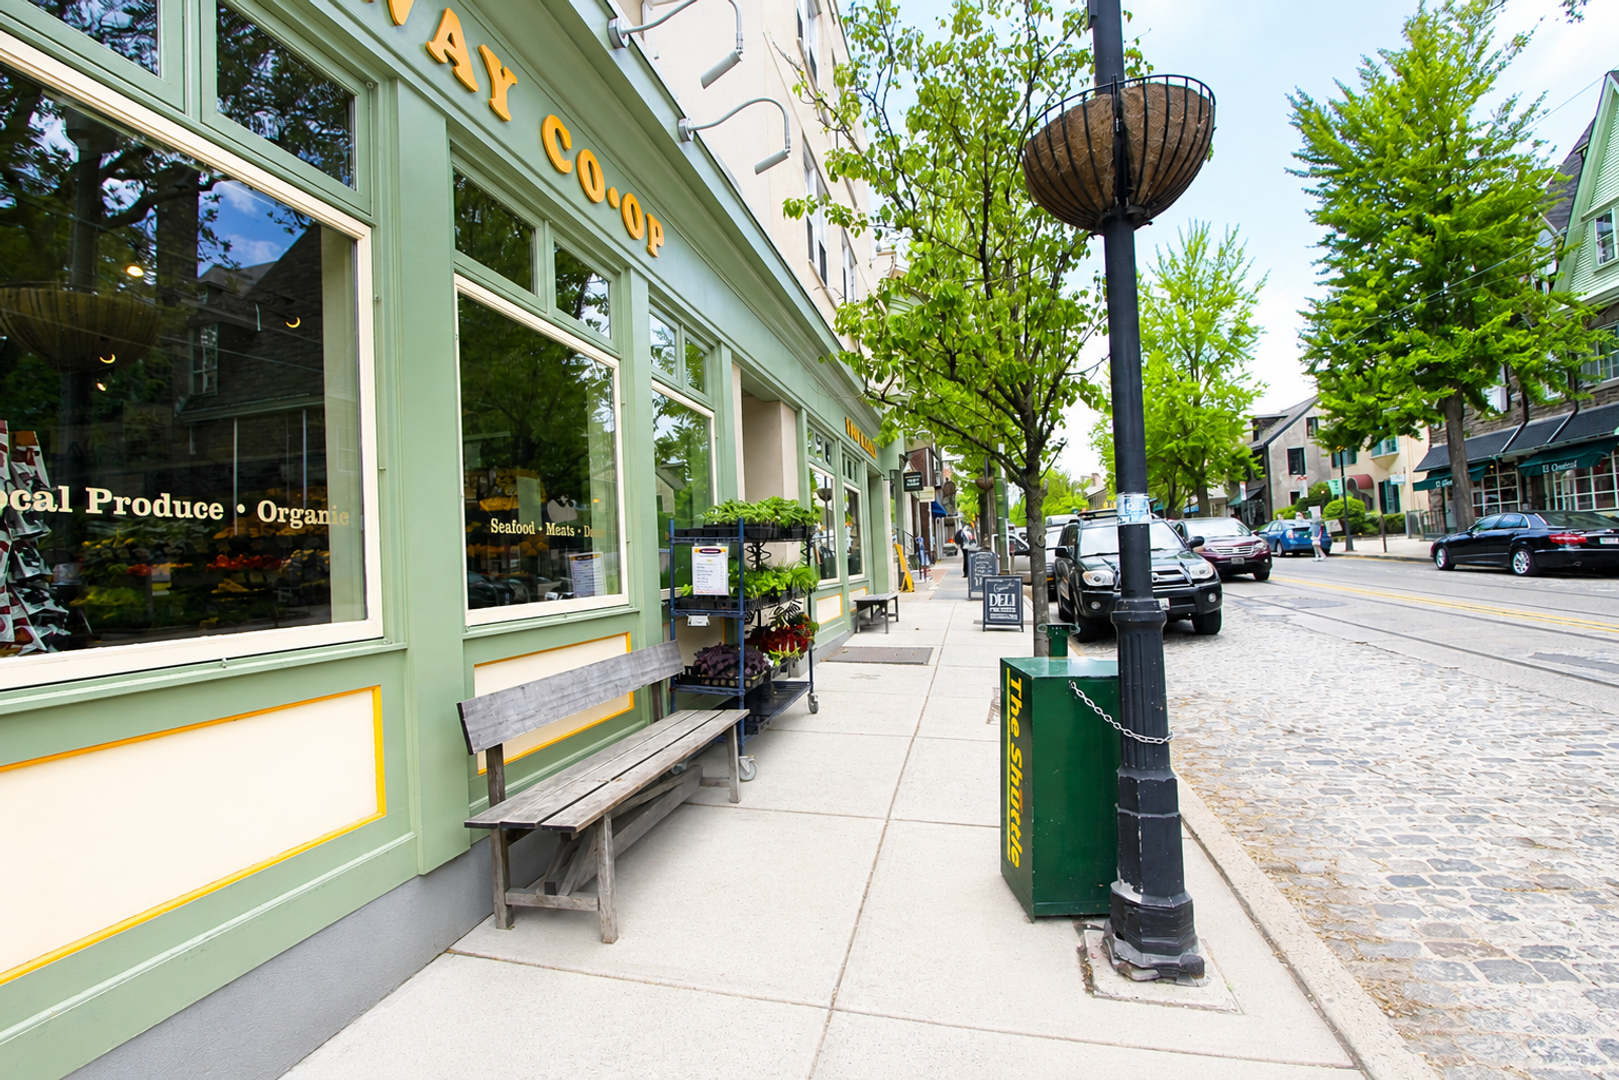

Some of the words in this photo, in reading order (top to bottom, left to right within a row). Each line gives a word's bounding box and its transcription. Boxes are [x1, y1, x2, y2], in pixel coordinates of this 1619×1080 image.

[365, 0, 519, 123] AY
[85, 487, 225, 520] Produce
[256, 500, 350, 529] Organic
[490, 518, 536, 535] Seafood
[545, 522, 576, 537] Meats
[988, 593, 1016, 607] DELI
[1010, 677, 1023, 738] The
[1010, 742, 1024, 868] Shuttle
